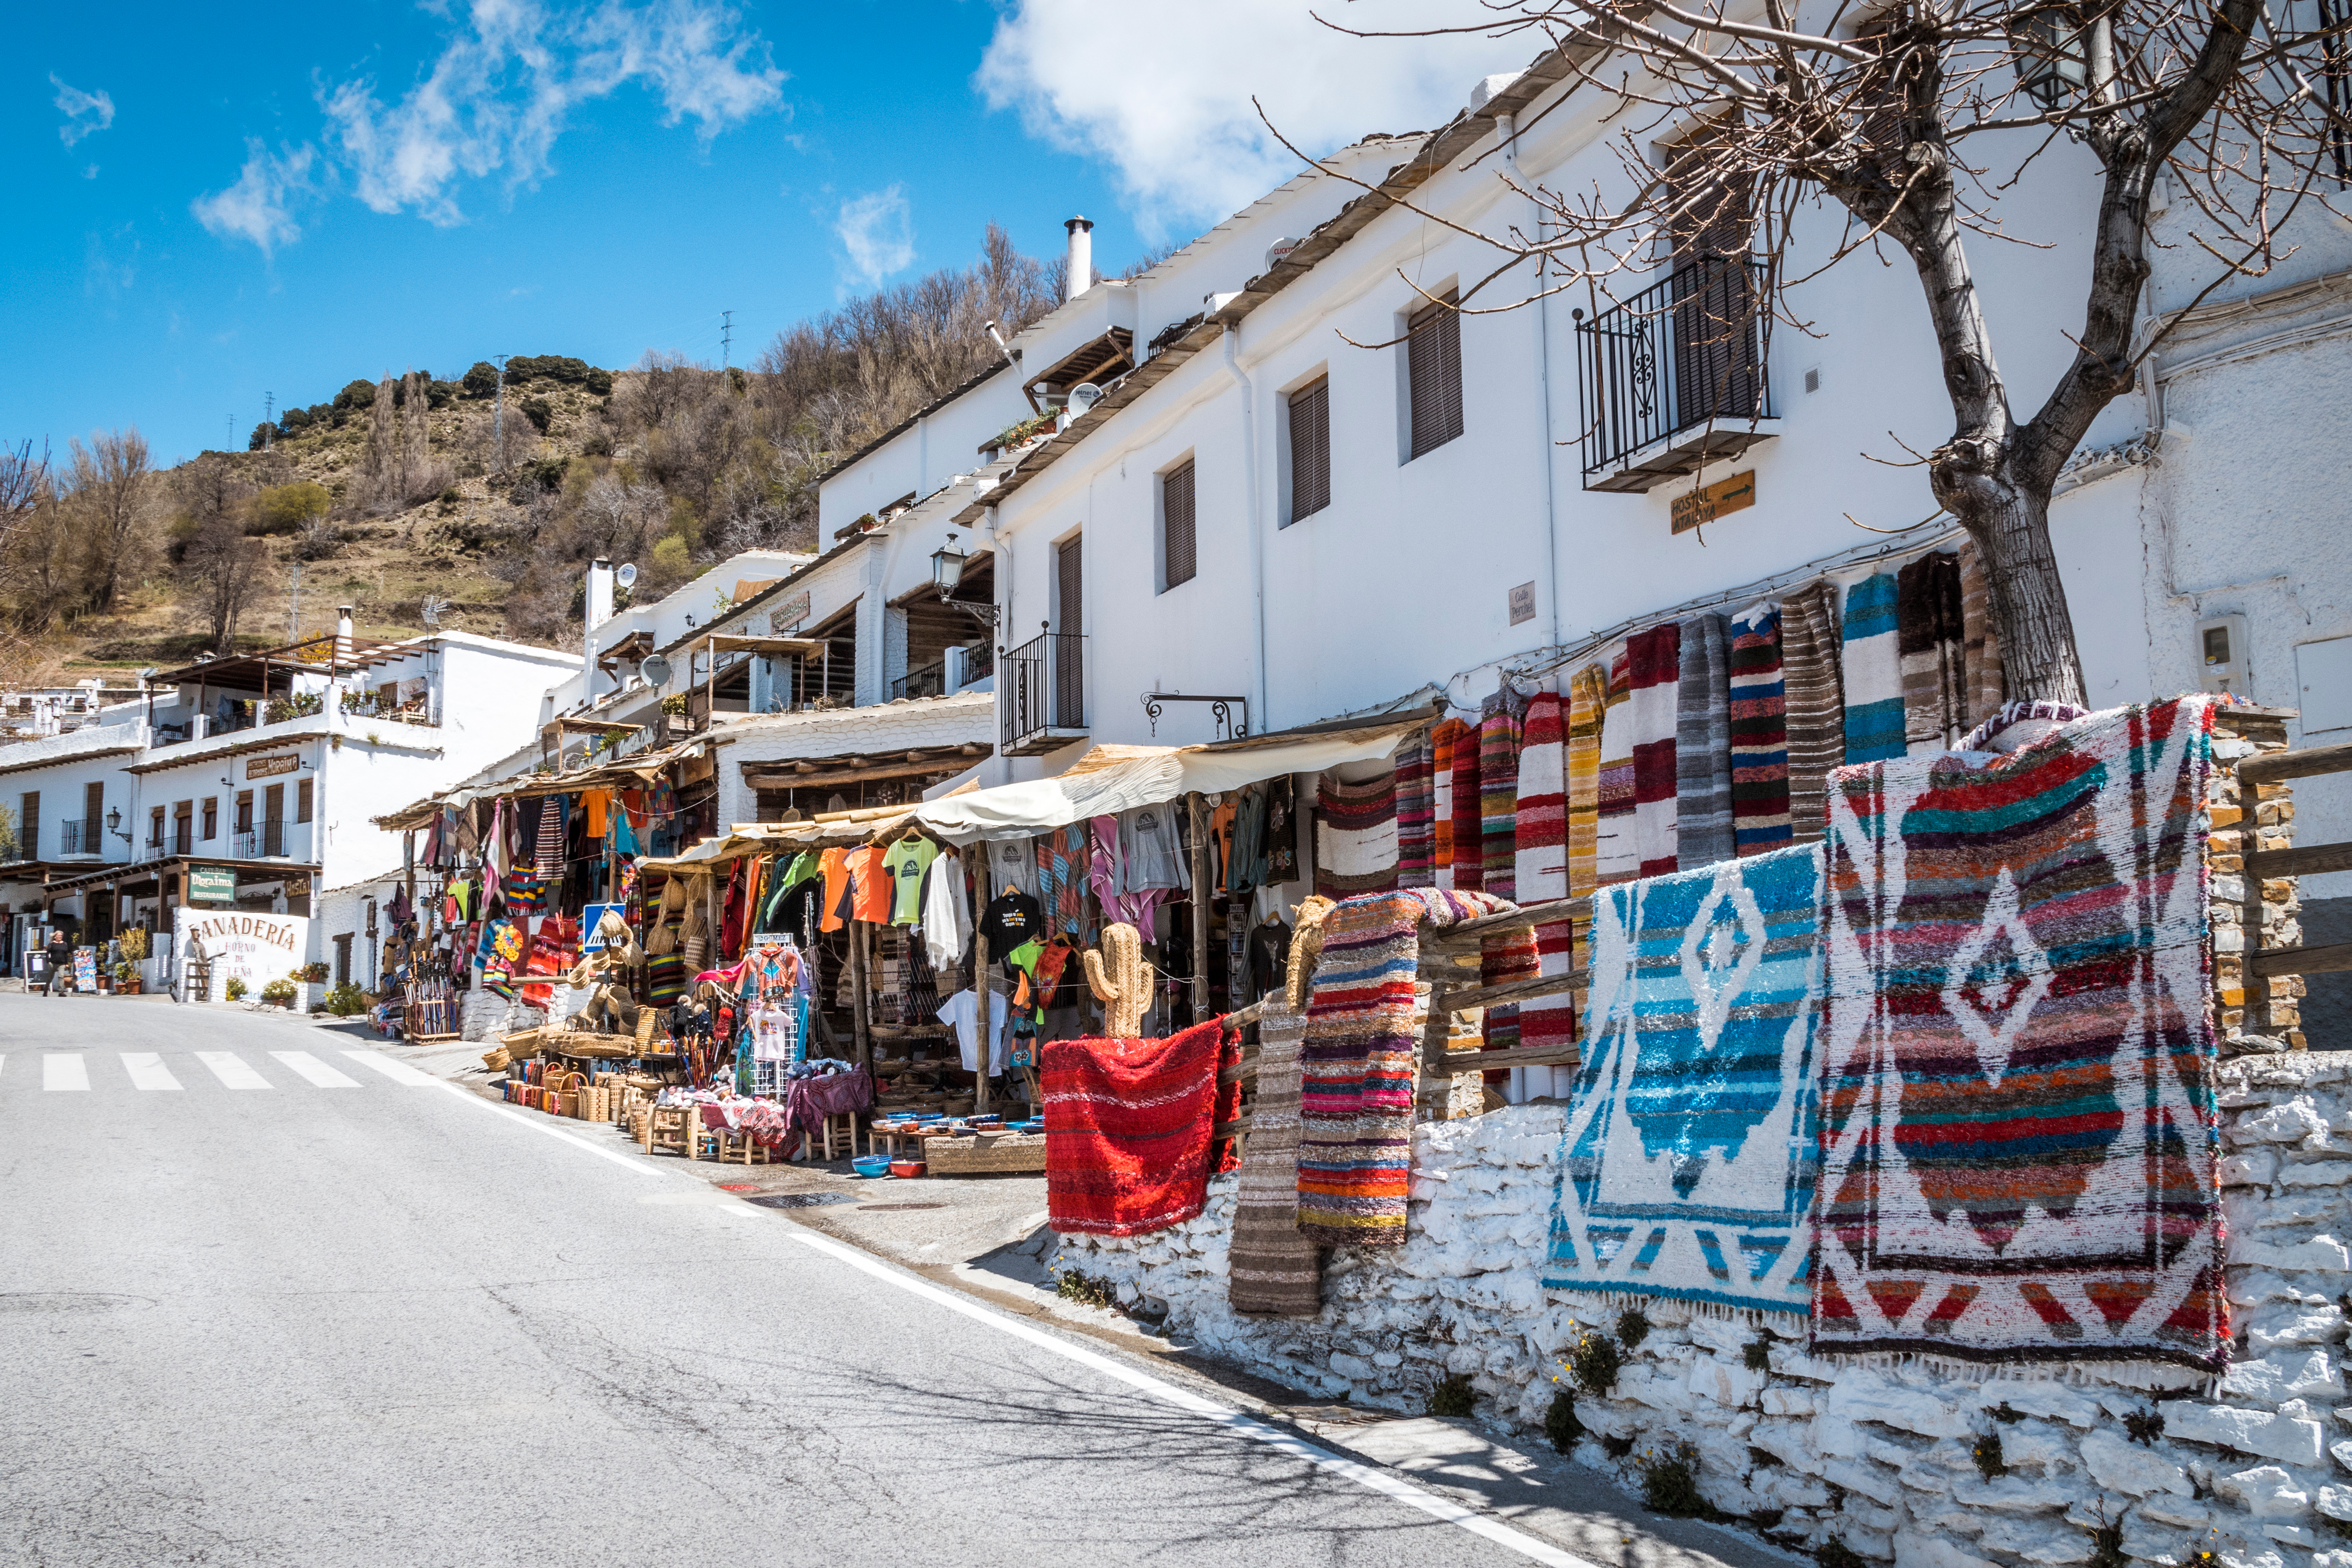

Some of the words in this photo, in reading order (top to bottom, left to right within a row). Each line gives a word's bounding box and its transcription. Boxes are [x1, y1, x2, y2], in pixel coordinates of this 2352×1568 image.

[1515, 588, 1529, 603] Calle
[1512, 599, 1533, 618] Perchel
[191, 873, 234, 888] Moraima
[188, 917, 296, 952] ANADERÍA
[225, 941, 255, 952] HORNO
[228, 966, 252, 977] LEÑA
